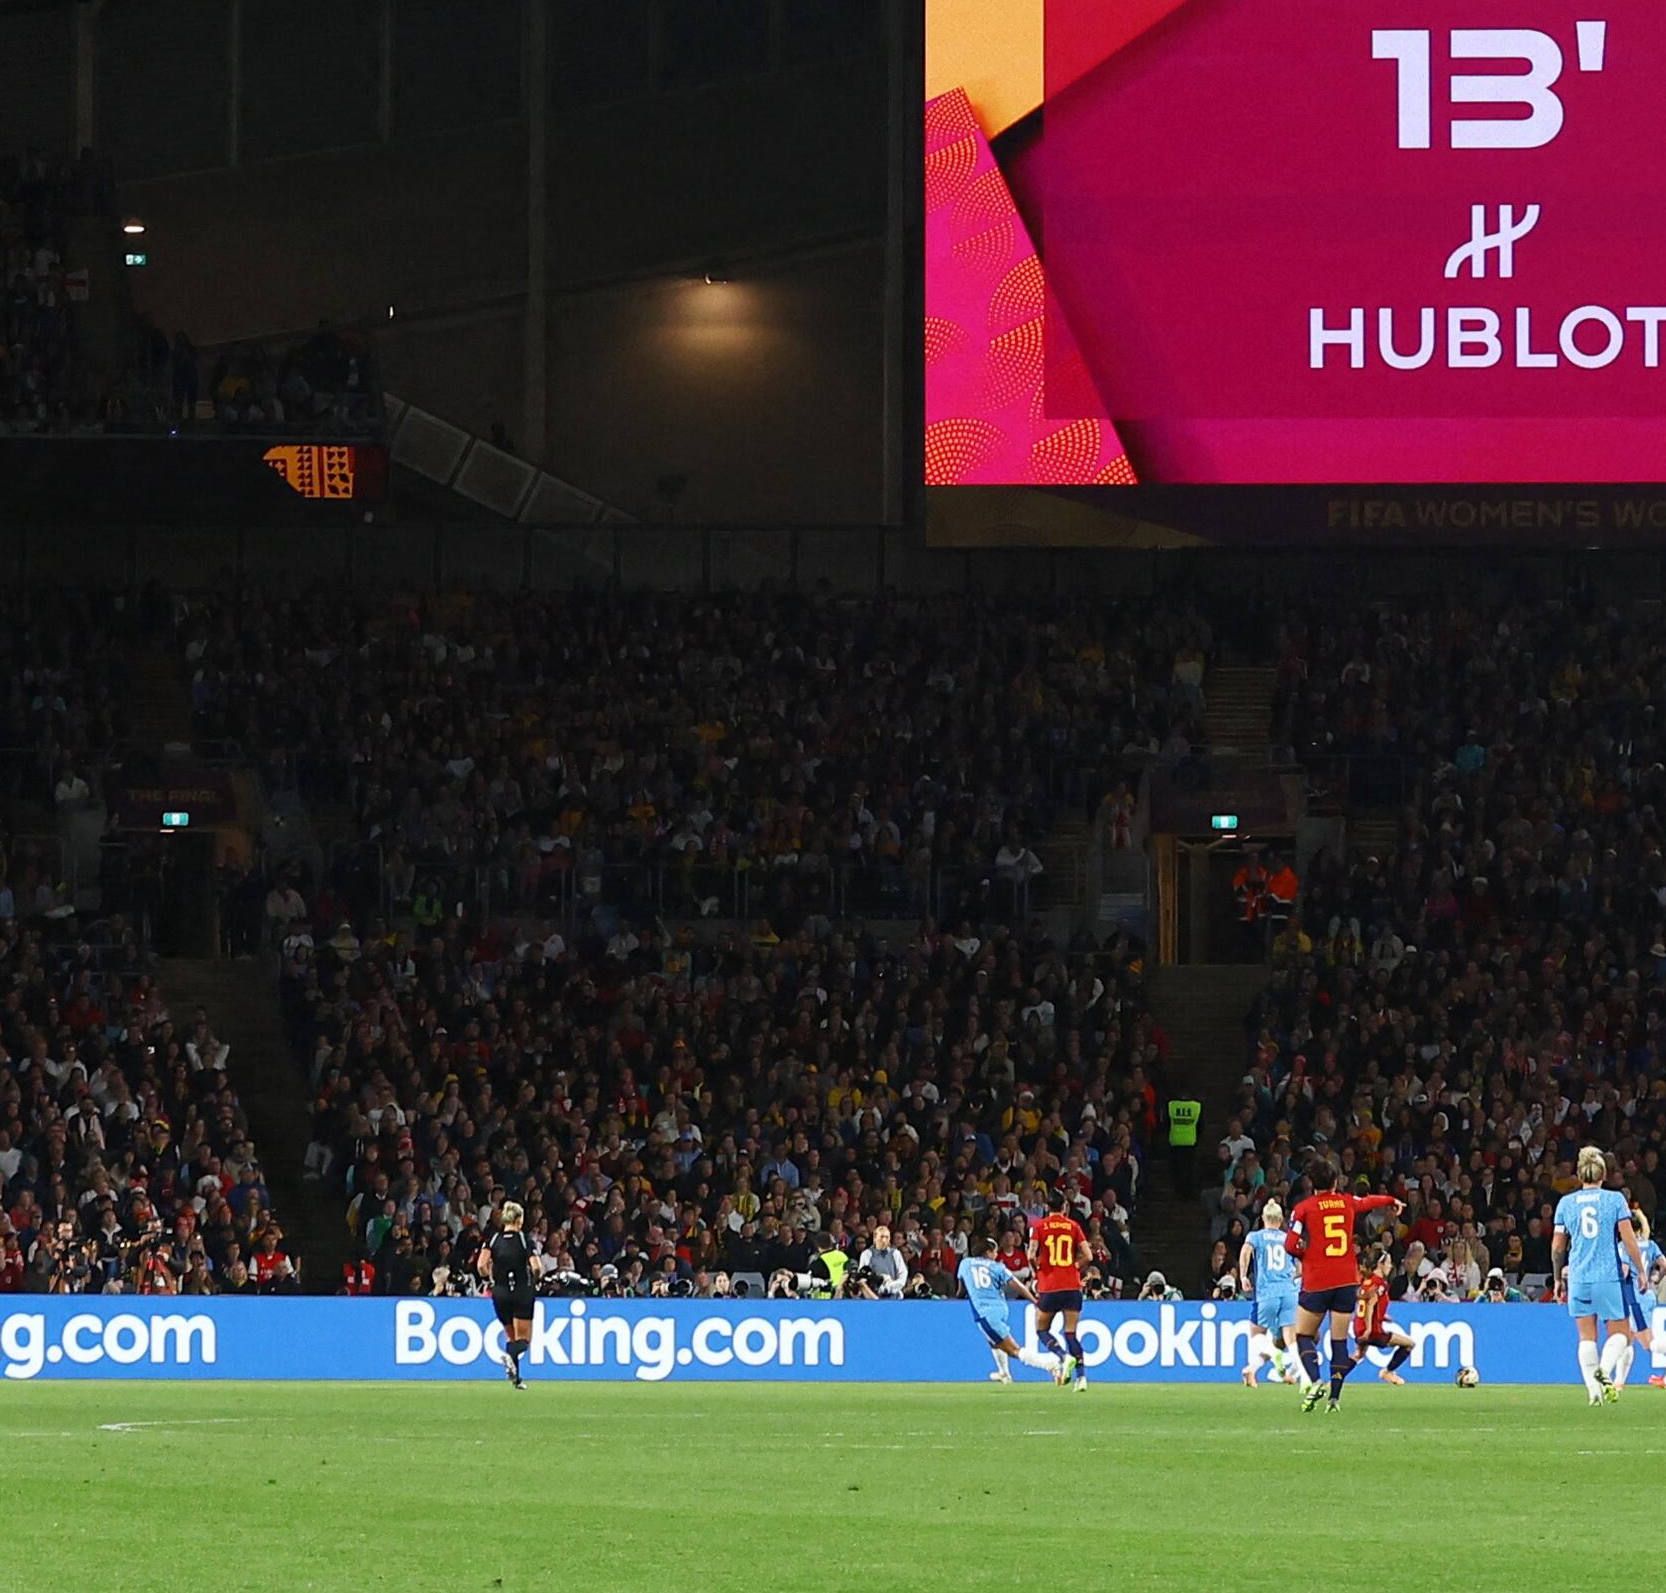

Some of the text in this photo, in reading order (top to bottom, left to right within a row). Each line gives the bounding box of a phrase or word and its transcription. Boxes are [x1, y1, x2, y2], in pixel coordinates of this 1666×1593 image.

[1373, 21, 1605, 149] 13'
[1328, 501, 1406, 529] FIFA
[1416, 500, 1601, 529] WOMEN'S
[1323, 1215, 1348, 1256] 5
[1581, 1206, 1598, 1239] 6
[1044, 1234, 1073, 1267] 10
[1266, 1244, 1285, 1271] 19
[971, 1266, 992, 1289] 16
